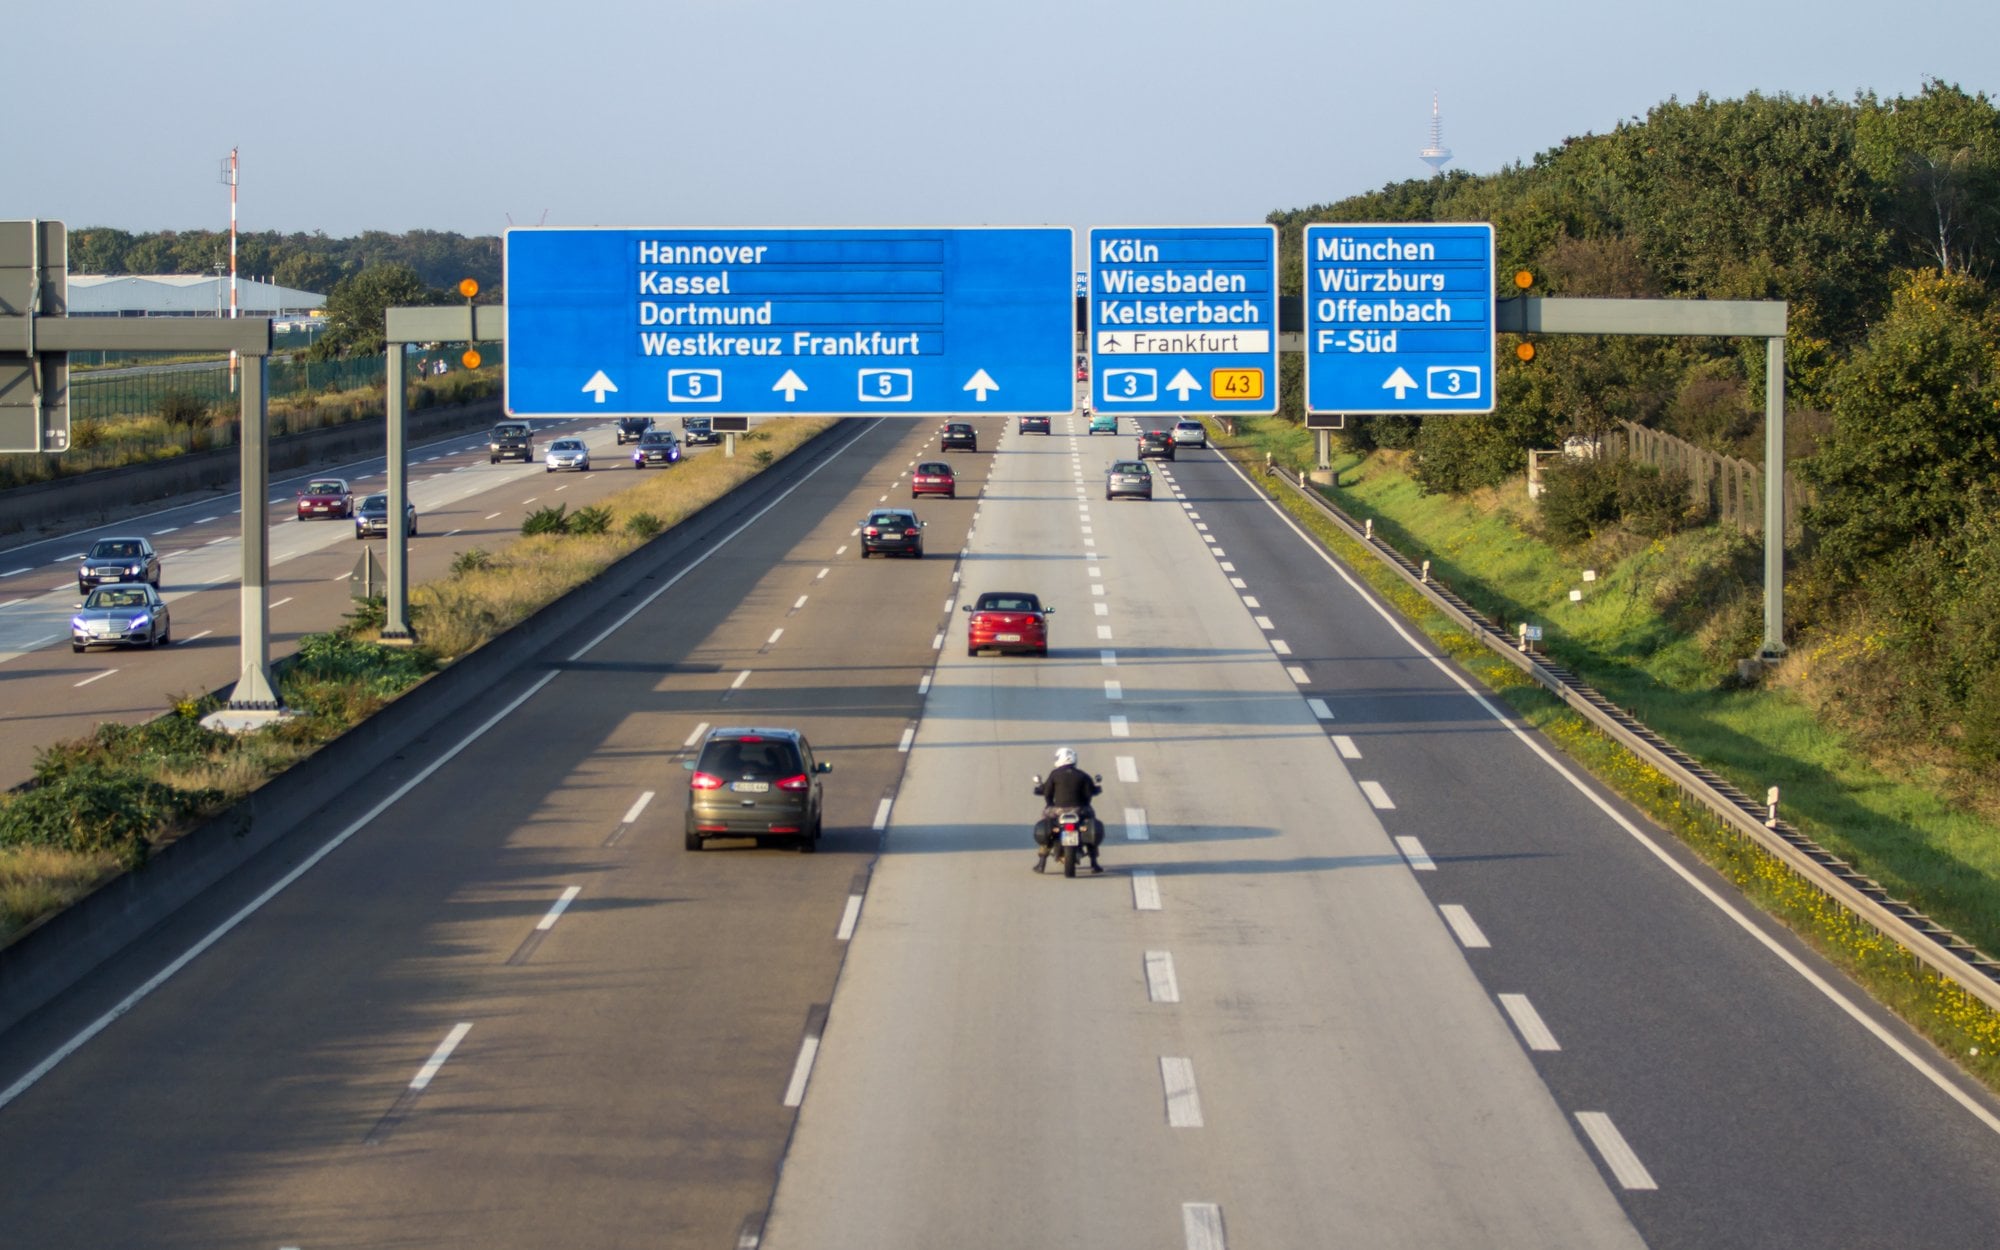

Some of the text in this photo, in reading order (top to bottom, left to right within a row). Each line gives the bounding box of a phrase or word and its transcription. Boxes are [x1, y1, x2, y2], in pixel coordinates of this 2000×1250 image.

[640, 240, 768, 264] Hannover
[1100, 239, 1159, 263] Köln
[1317, 238, 1435, 261] München
[640, 271, 730, 295] Kassel
[1101, 269, 1246, 293] Wiesbaden
[1318, 268, 1445, 292] Würzburg
[641, 302, 772, 326] Dortmund
[1101, 300, 1259, 324] Kelsterbach
[1318, 298, 1451, 322] Offenbach
[641, 331, 920, 356] Westkreuz Frankfurt
[1133, 333, 1239, 352] Frankfurt
[1318, 329, 1398, 353] F-Süd
[688, 376, 702, 396] 5
[879, 376, 893, 396] 5
[1123, 375, 1137, 395] 3
[1225, 375, 1250, 393] 43
[1447, 372, 1461, 392] 3
